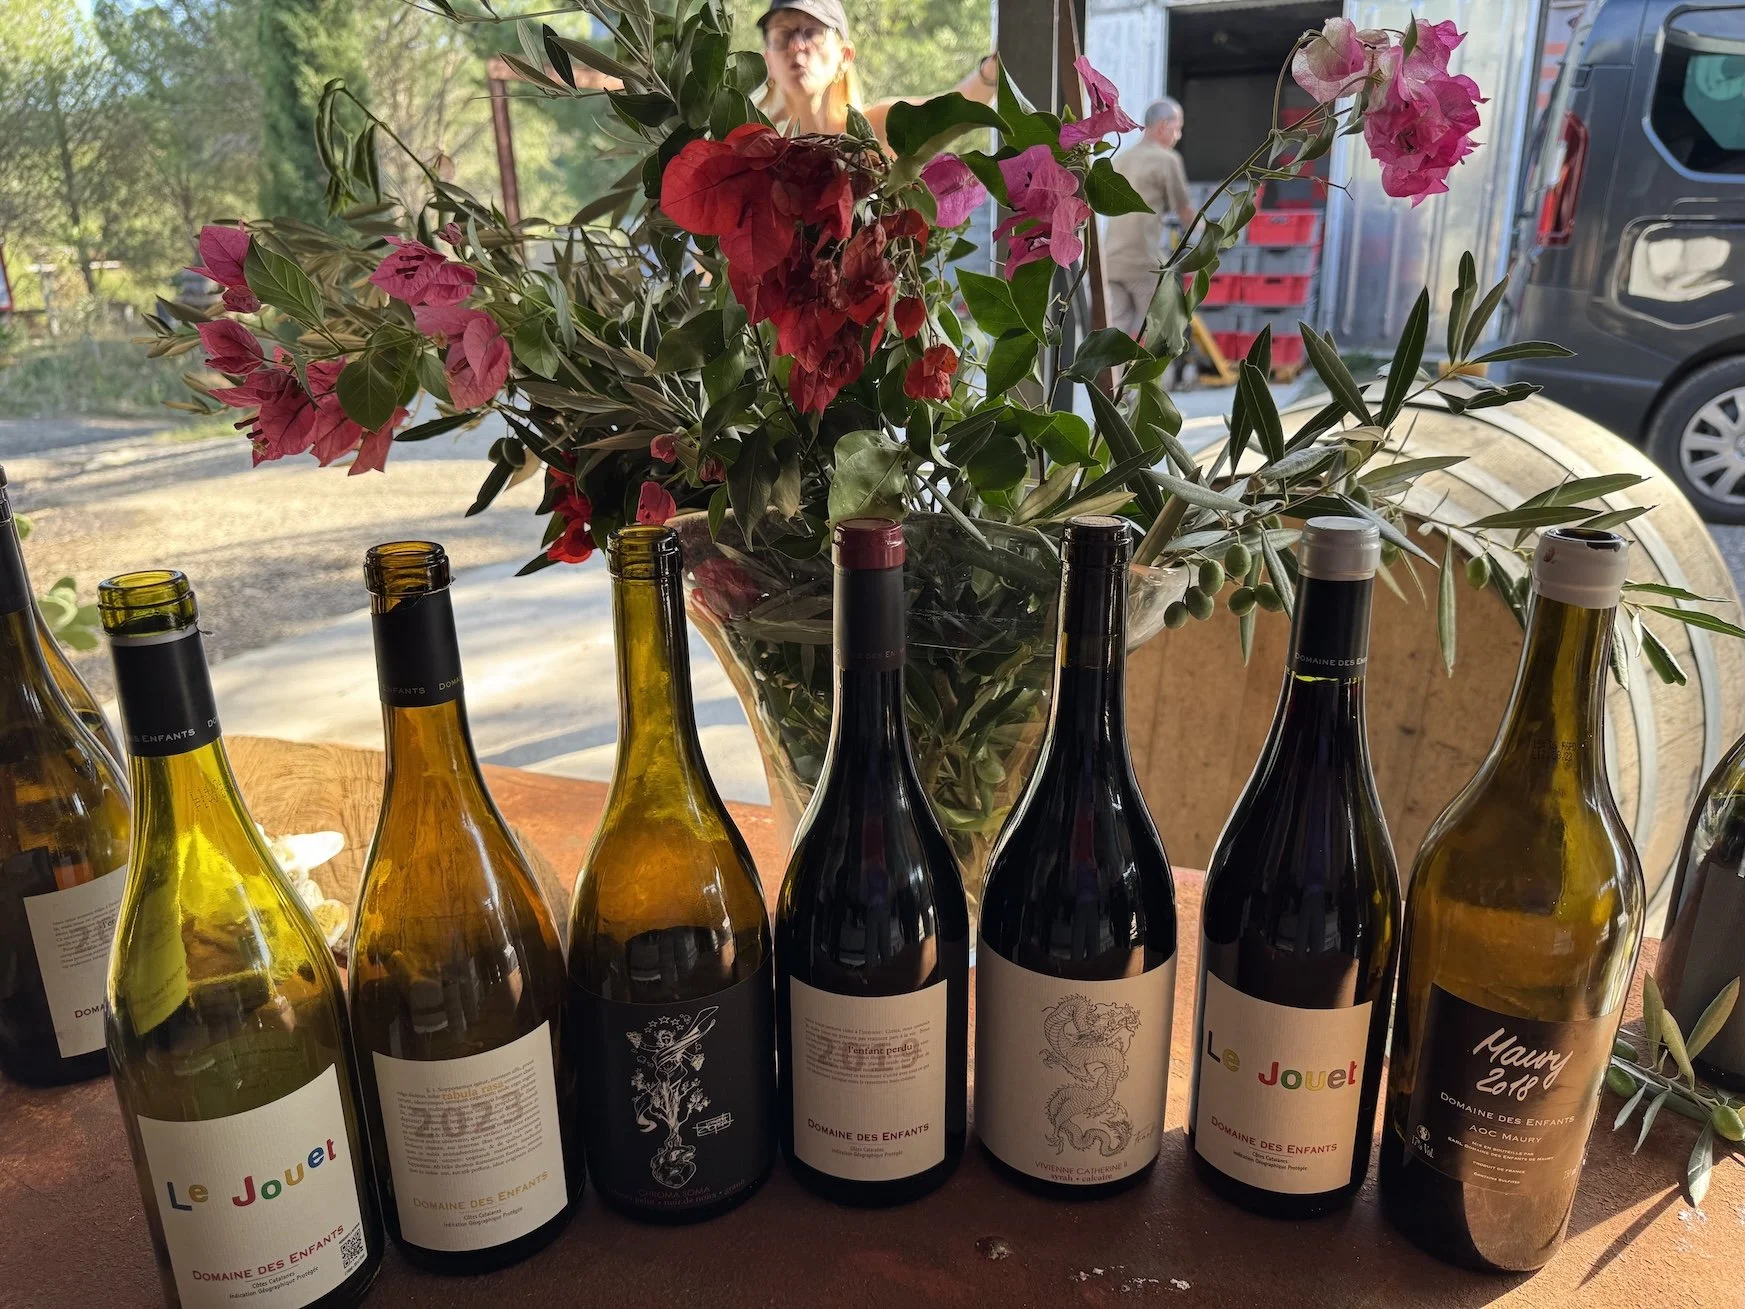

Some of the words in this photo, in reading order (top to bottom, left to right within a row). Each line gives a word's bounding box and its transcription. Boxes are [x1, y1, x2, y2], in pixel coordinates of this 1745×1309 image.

[1295, 652, 1336, 666] DOMAINE
[1338, 659, 1355, 667] DES
[141, 728, 196, 743] ENFANTS
[848, 1044, 885, 1055] l'enfant
[886, 1042, 913, 1055] perdu
[1472, 1027, 1573, 1090] Maury
[1207, 1030, 1240, 1073] Le
[1258, 1060, 1357, 1092] Jouet
[441, 1087, 478, 1101] tabula
[482, 1081, 505, 1094] rasa
[1475, 1067, 1539, 1101] 2018
[1440, 1091, 1494, 1120] DOMAINE
[1497, 1113, 1521, 1125] DES
[1526, 1115, 1575, 1127] ENFANTS
[808, 1118, 853, 1141] DOMAINE
[857, 1133, 878, 1142] DES
[882, 1122, 929, 1141] ENFANTS
[1211, 1116, 1256, 1146] DOMAINE
[1260, 1140, 1283, 1152] DES
[1287, 1143, 1338, 1154] ENFANTS
[1468, 1124, 1498, 1138] AOC
[1501, 1132, 1543, 1144] MAURY
[167, 1181, 209, 1211] Le
[232, 1138, 337, 1207] Jouet
[1034, 1160, 1075, 1175] VIVIENNE
[1075, 1161, 1122, 1176] CATHERINE
[1051, 1174, 1073, 1183] syrah
[1081, 1173, 1113, 1183] calcaire
[412, 1197, 465, 1210] DOMAINE
[470, 1196, 495, 1209] DES
[497, 1171, 549, 1201] ENFANTS
[681, 1185, 711, 1197] SOMA
[192, 1269, 253, 1282] DOMAINE
[257, 1259, 285, 1276] DES
[288, 1225, 345, 1264] ENFANTS
[229, 1290, 257, 1299] Indication
[257, 1278, 296, 1295] Géographique
[252, 1280, 268, 1290] Côtes
[268, 1271, 296, 1285] Catalanes
